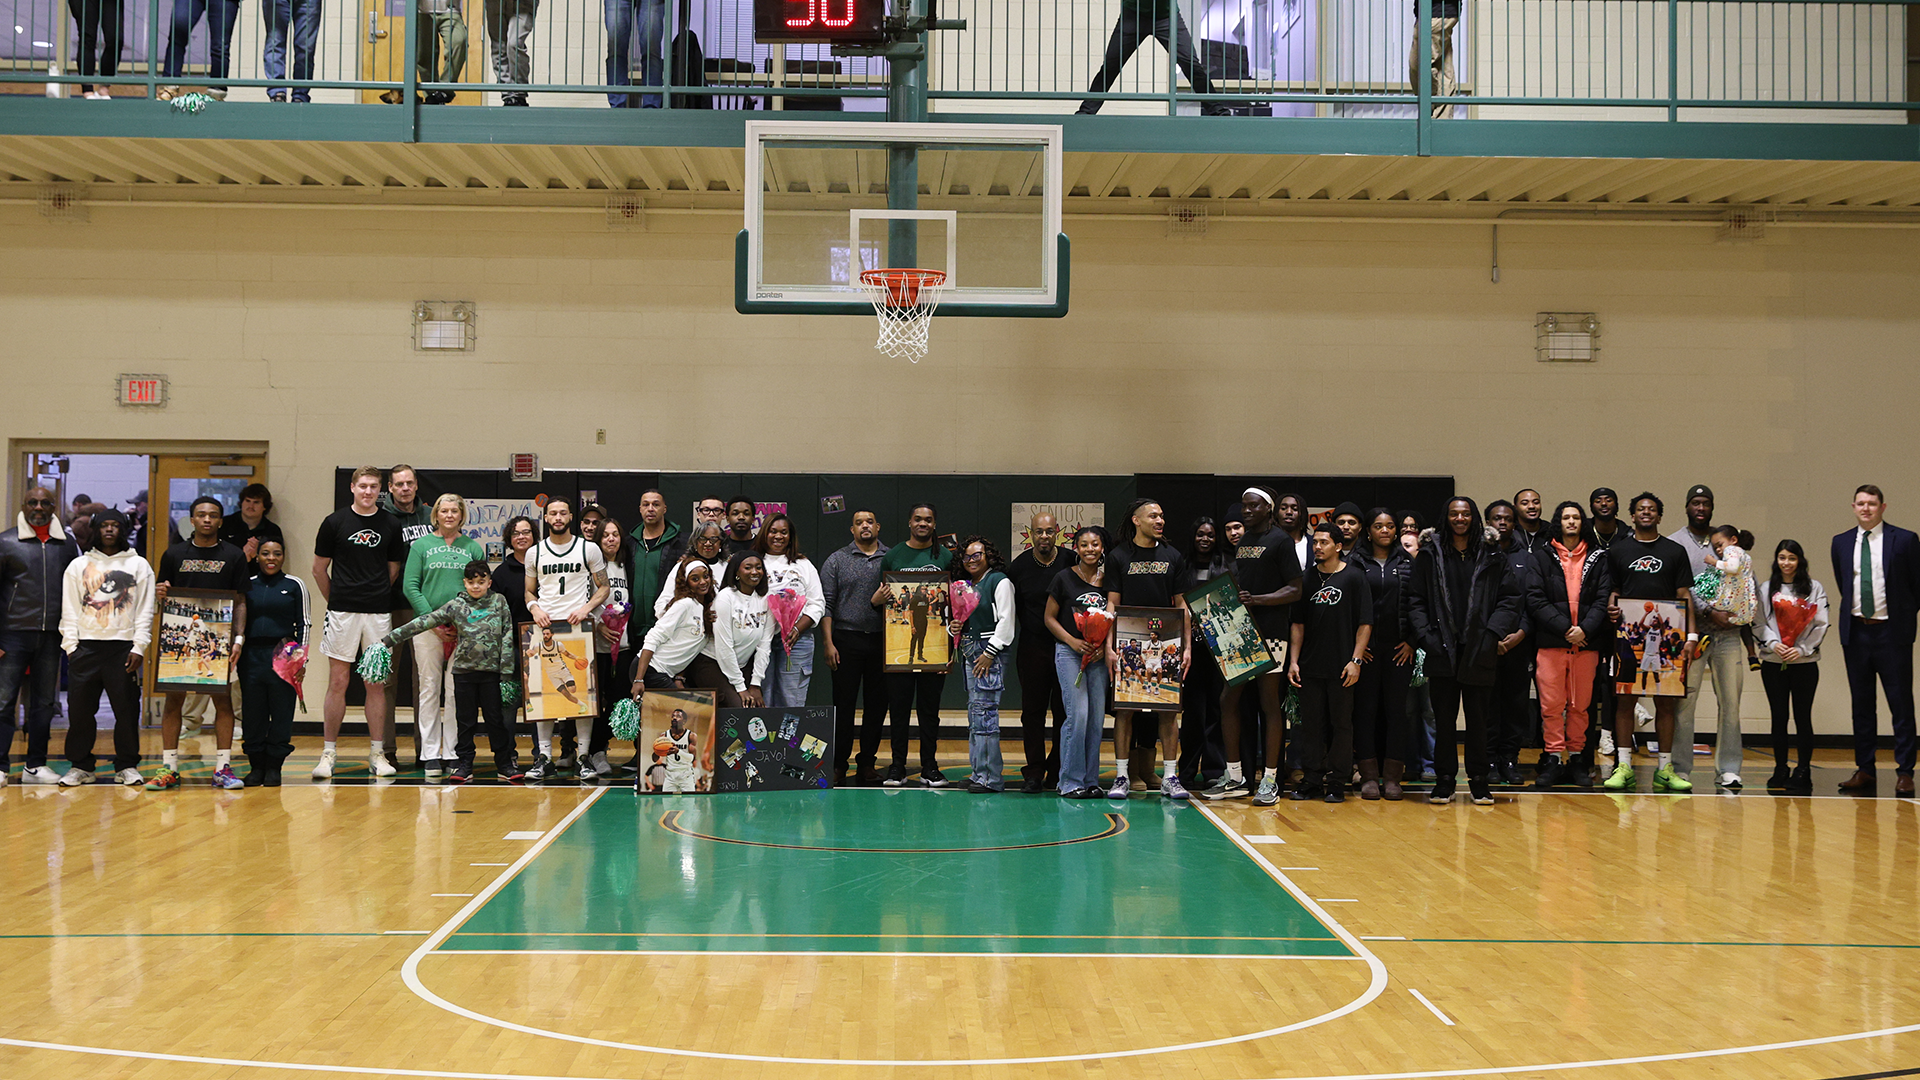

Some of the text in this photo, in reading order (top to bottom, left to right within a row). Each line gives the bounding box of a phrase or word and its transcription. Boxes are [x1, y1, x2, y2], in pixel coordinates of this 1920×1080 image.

[128, 380, 157, 402] EXIT
[428, 561, 466, 570] COLLEG
[542, 562, 582, 575] NICHOLS
[558, 576, 566, 595] 1
